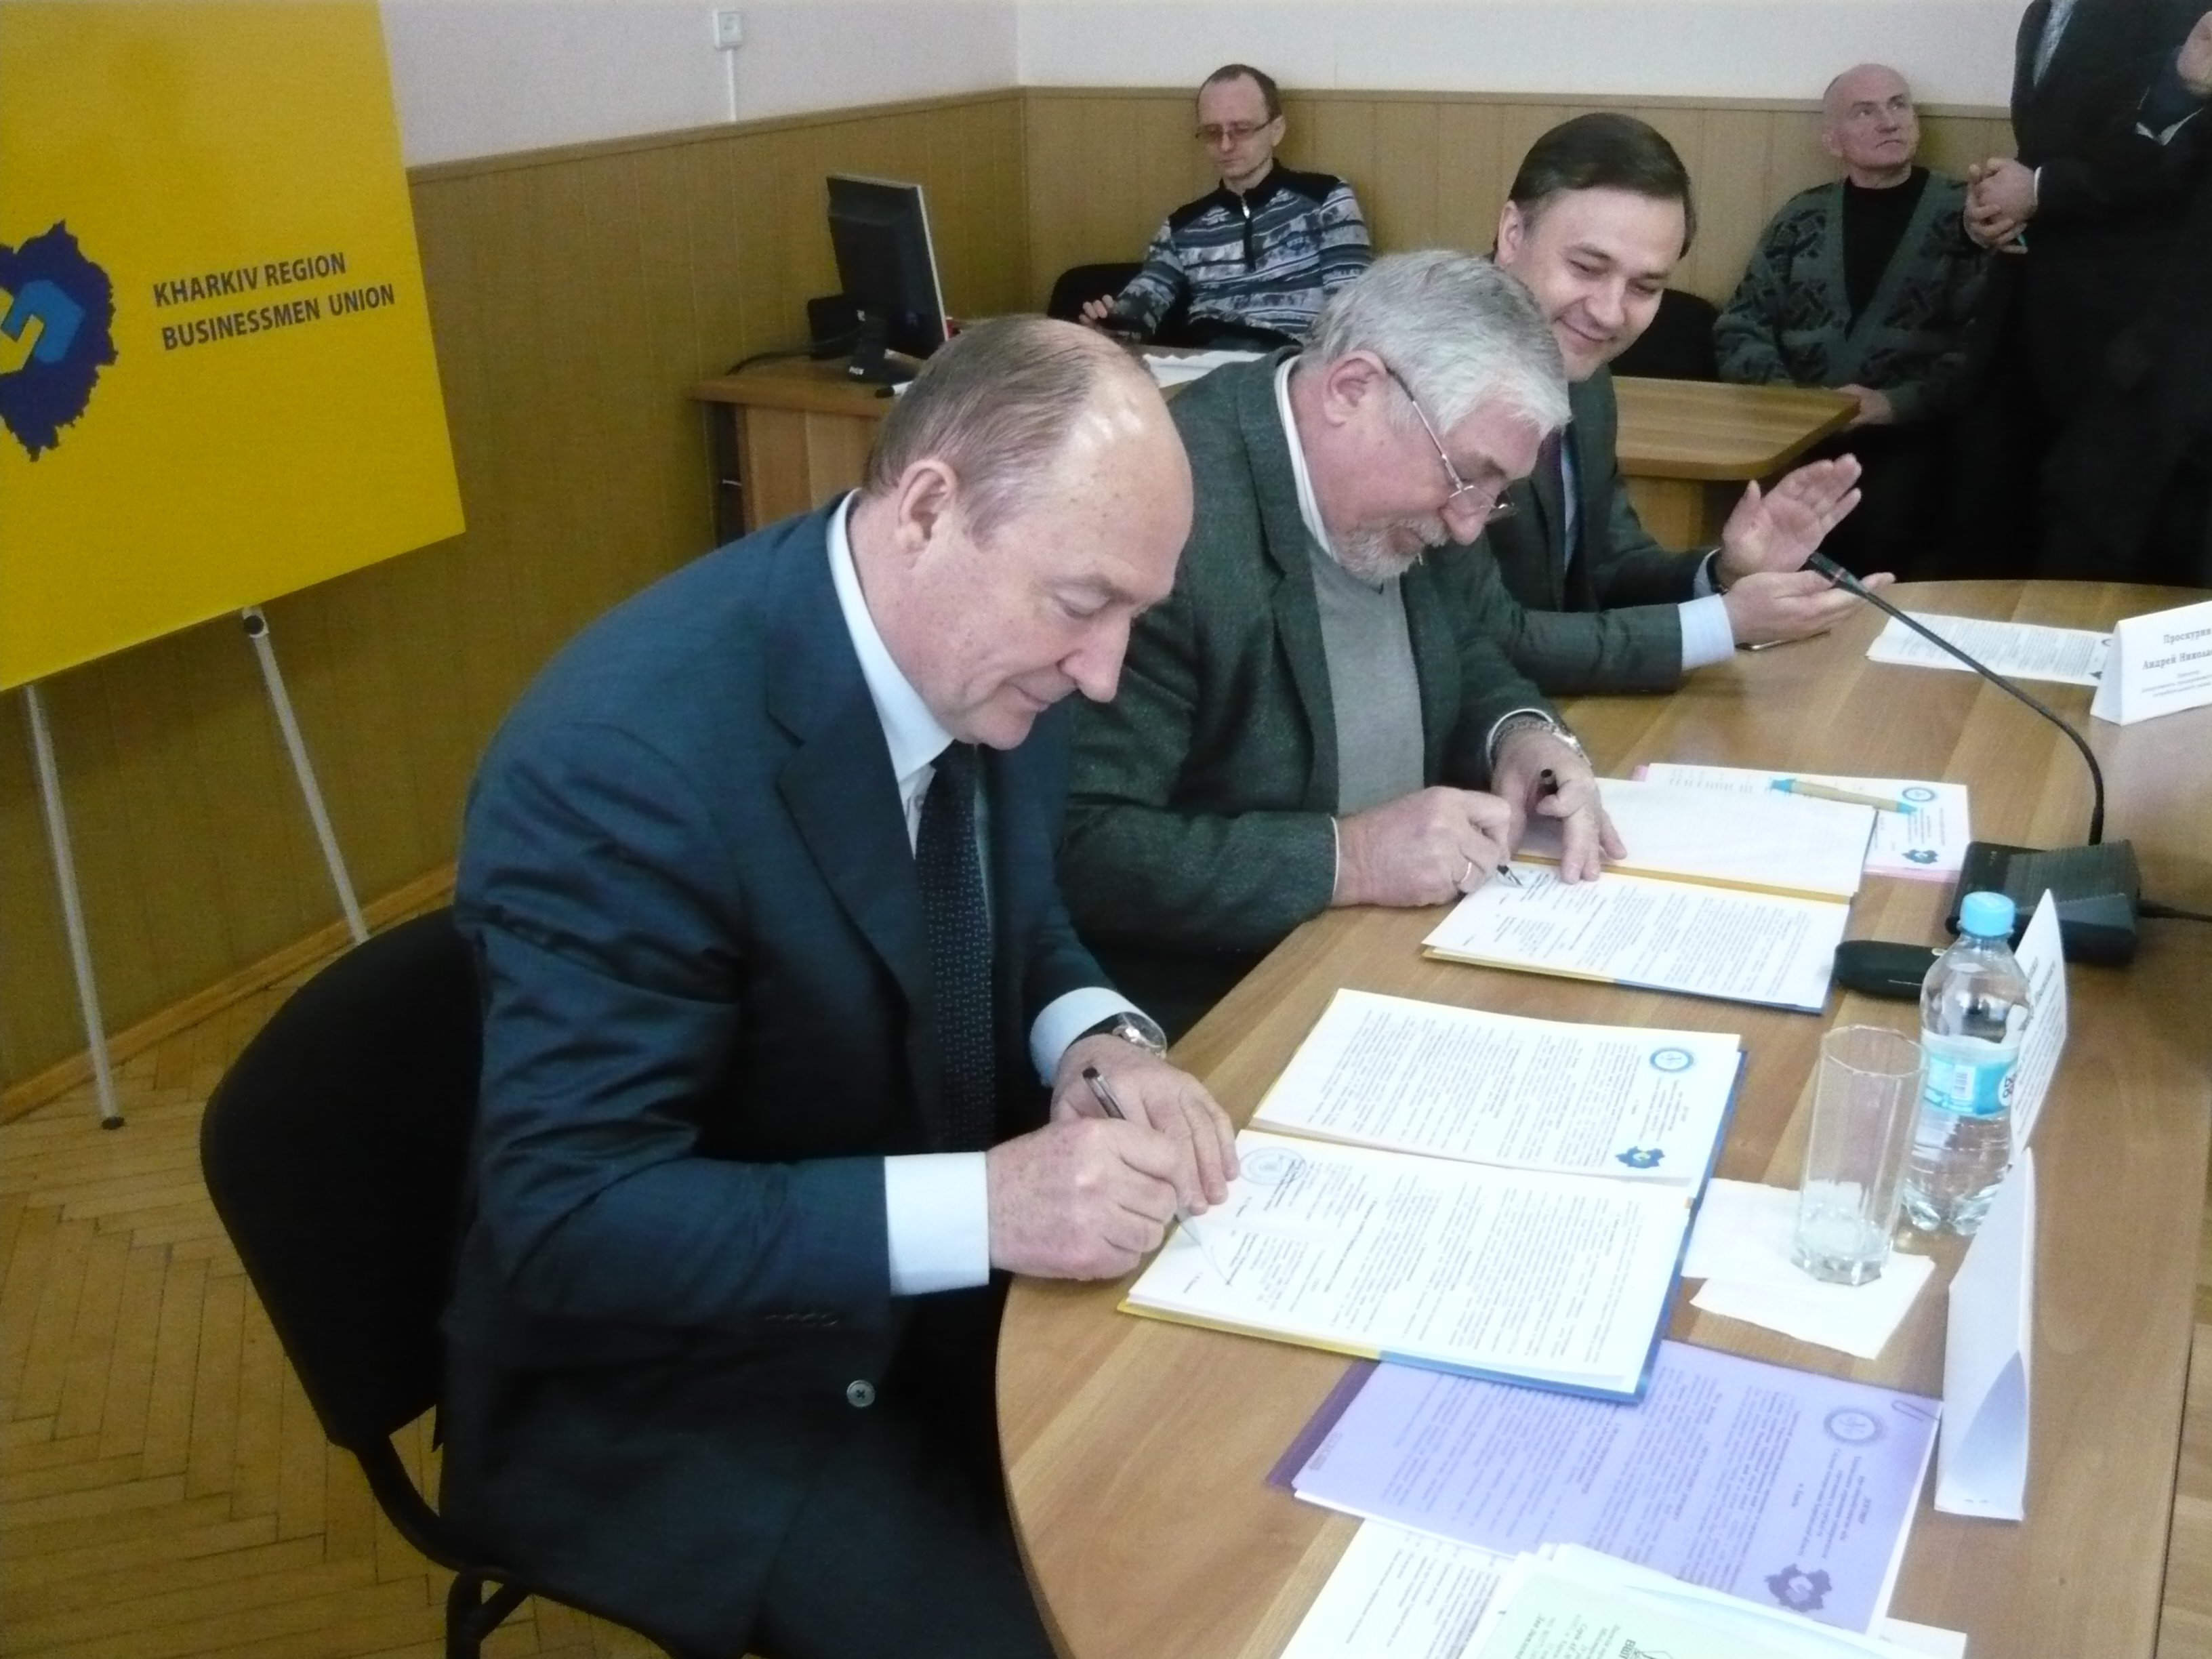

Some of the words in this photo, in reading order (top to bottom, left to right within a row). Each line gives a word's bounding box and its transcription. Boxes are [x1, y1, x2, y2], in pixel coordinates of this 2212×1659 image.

[152, 266, 258, 308] KHARKIV
[264, 251, 346, 287] REGION
[162, 297, 321, 351] BUSINESSMEN
[328, 283, 396, 316] UNION
[2142, 654, 2177, 670] Андрей
